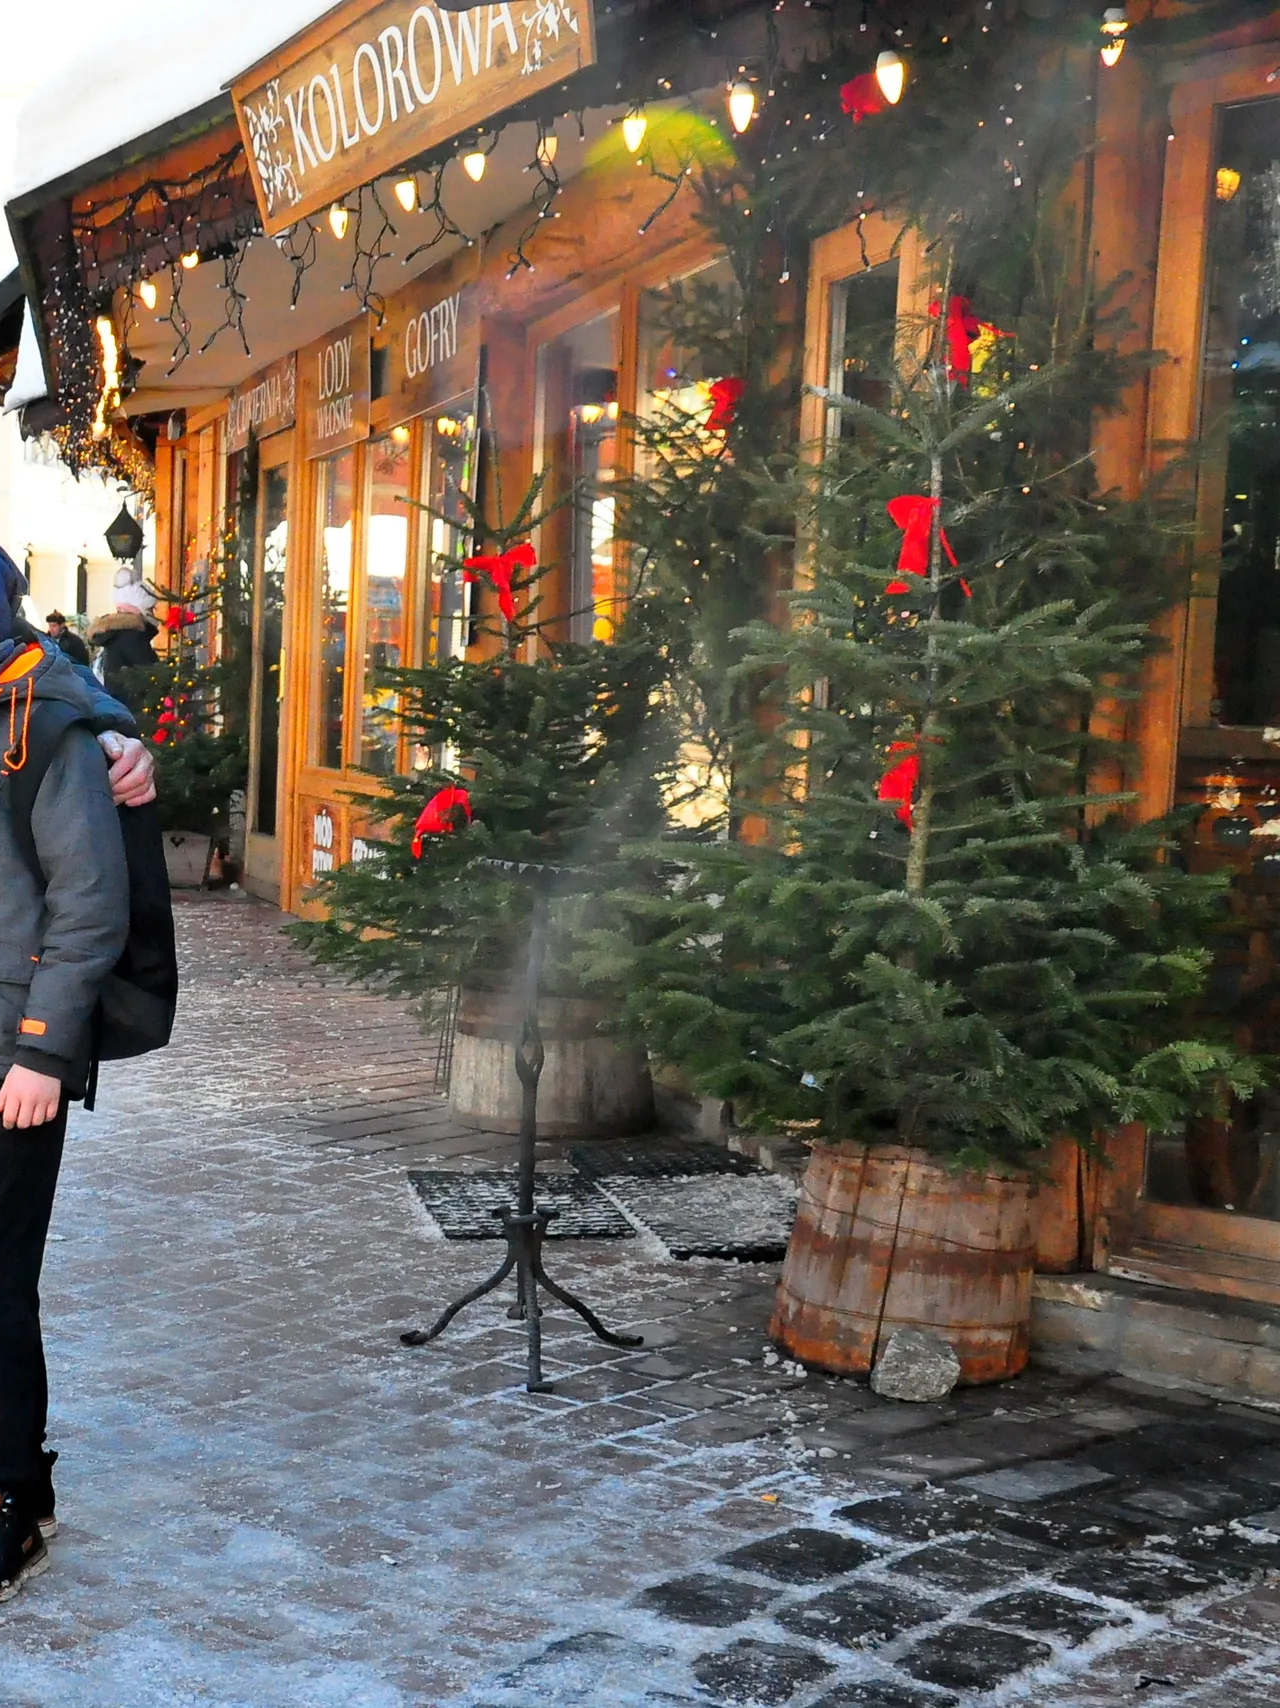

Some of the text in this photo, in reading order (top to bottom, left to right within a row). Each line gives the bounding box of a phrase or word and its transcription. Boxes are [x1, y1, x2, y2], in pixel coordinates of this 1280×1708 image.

[284, 0, 518, 175] KOLOROWA
[318, 335, 352, 400] LODY
[404, 292, 461, 378] GOFRY
[236, 372, 282, 436] CUKIERNIA
[317, 394, 354, 440] WŁOSKIE
